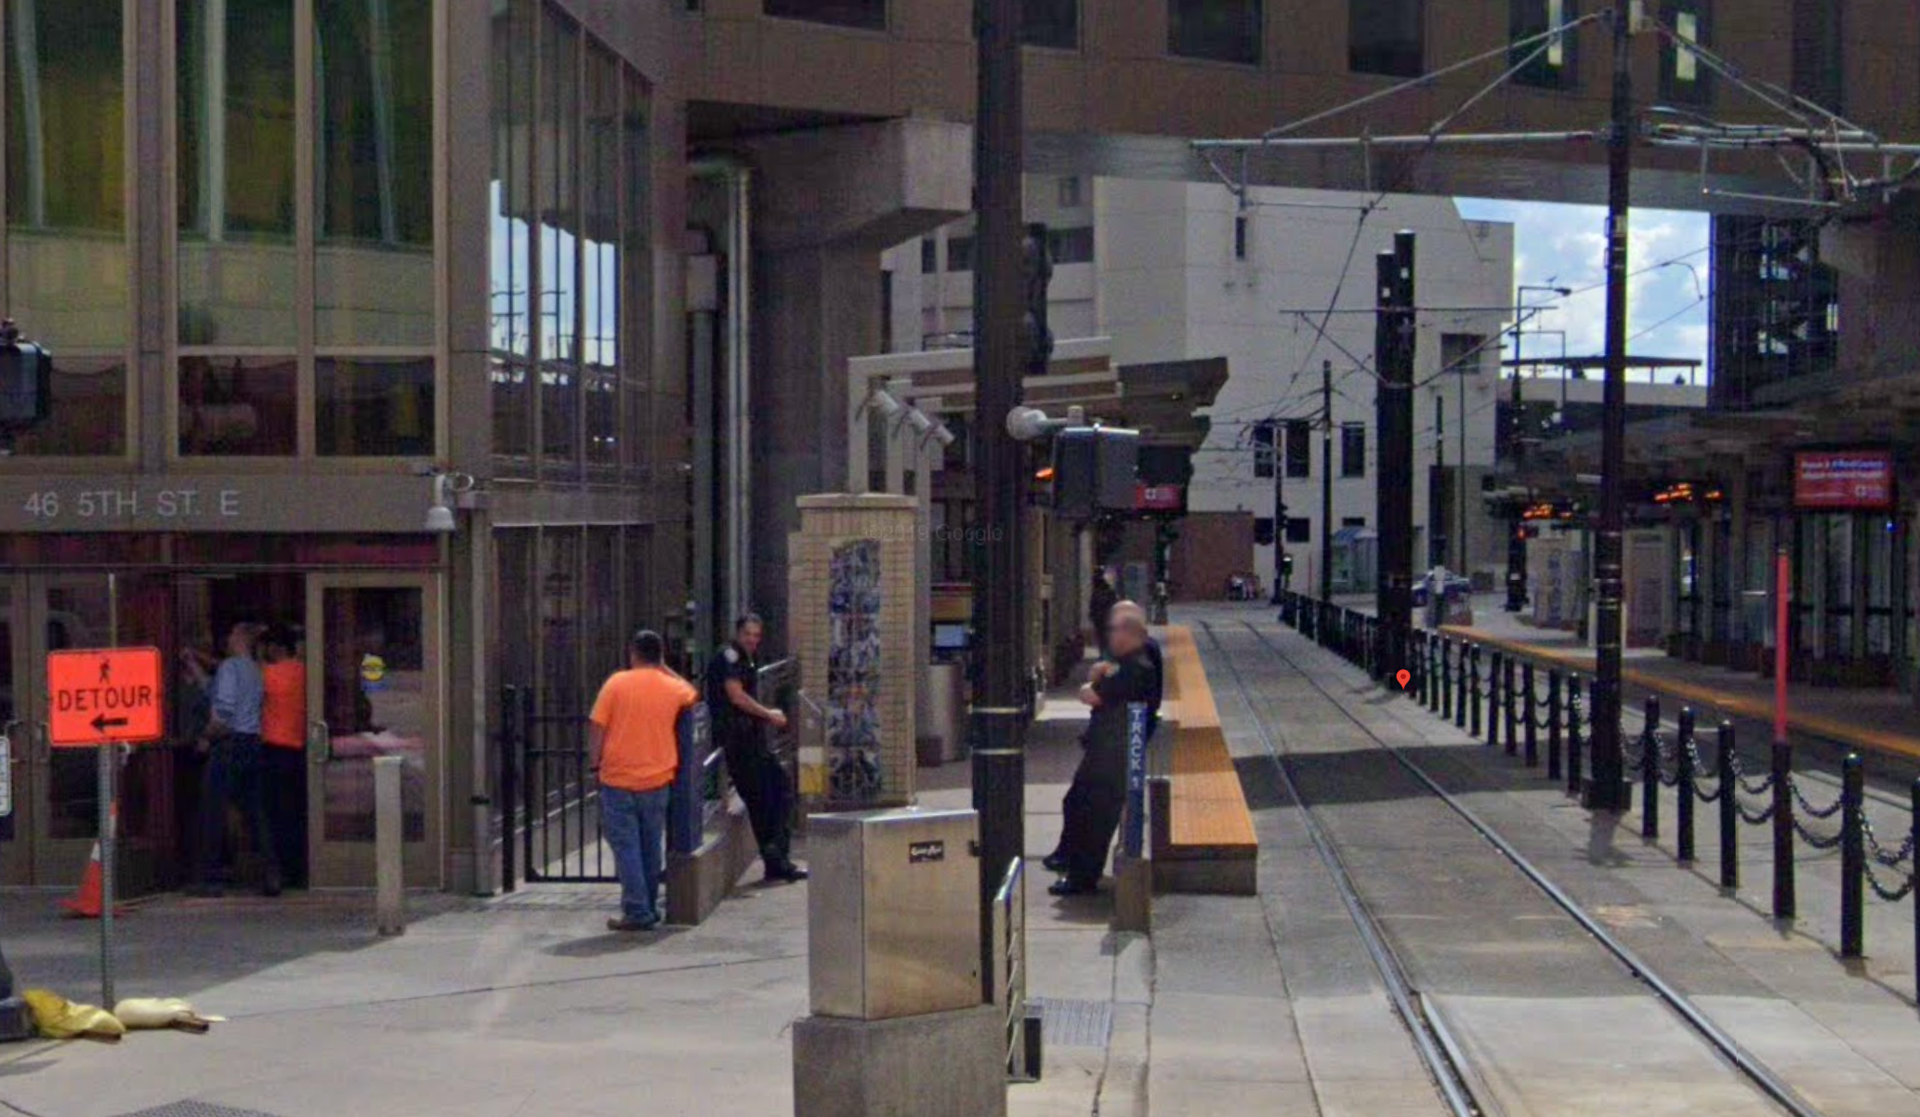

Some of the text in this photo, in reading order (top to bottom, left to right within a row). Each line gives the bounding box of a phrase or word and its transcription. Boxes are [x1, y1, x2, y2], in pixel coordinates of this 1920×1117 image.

[24, 489, 240, 517] 46 5TH ST. E
[58, 685, 152, 712] DETOUR
[1131, 708, 1143, 788] TRACK 1
